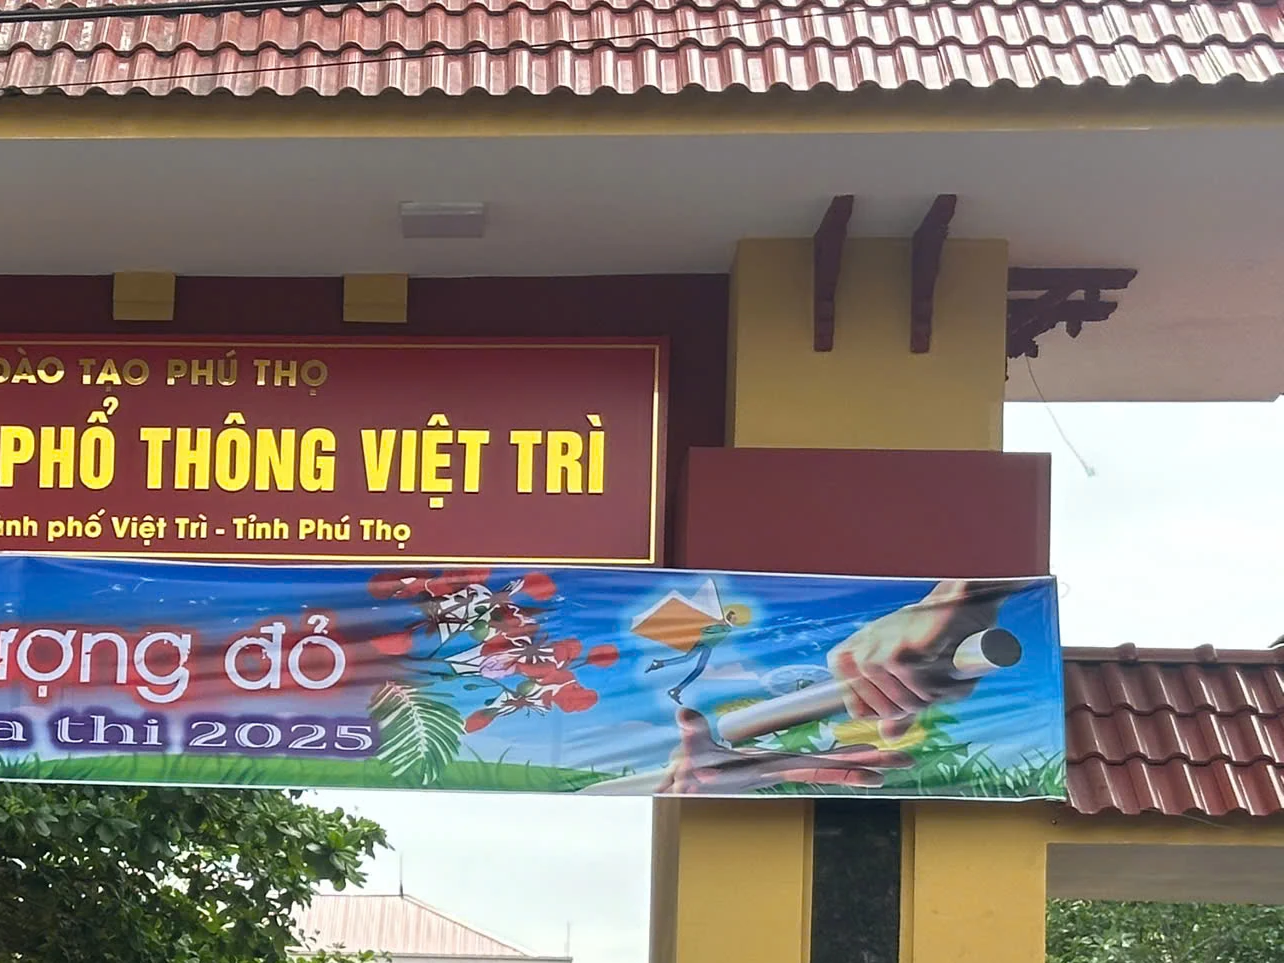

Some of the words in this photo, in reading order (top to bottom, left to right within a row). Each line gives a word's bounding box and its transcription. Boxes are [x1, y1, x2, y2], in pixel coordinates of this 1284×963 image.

[79, 357, 149, 392] TẠO
[167, 348, 238, 386] PHÚ
[253, 358, 328, 395] THỌ
[0, 397, 119, 490] PHỔ
[140, 412, 335, 492] THÔNG
[361, 413, 489, 508] VIỆT
[510, 413, 605, 495] TRÌ
[47, 508, 105, 543] phố
[112, 515, 167, 546] Việt
[175, 514, 207, 540] Trì
[232, 511, 289, 540] Tỉnh
[299, 514, 351, 541] Phú
[360, 519, 411, 549] Thọ
[223, 613, 347, 692] đỏ
[57, 715, 163, 747] thi
[188, 722, 374, 752] 2025
